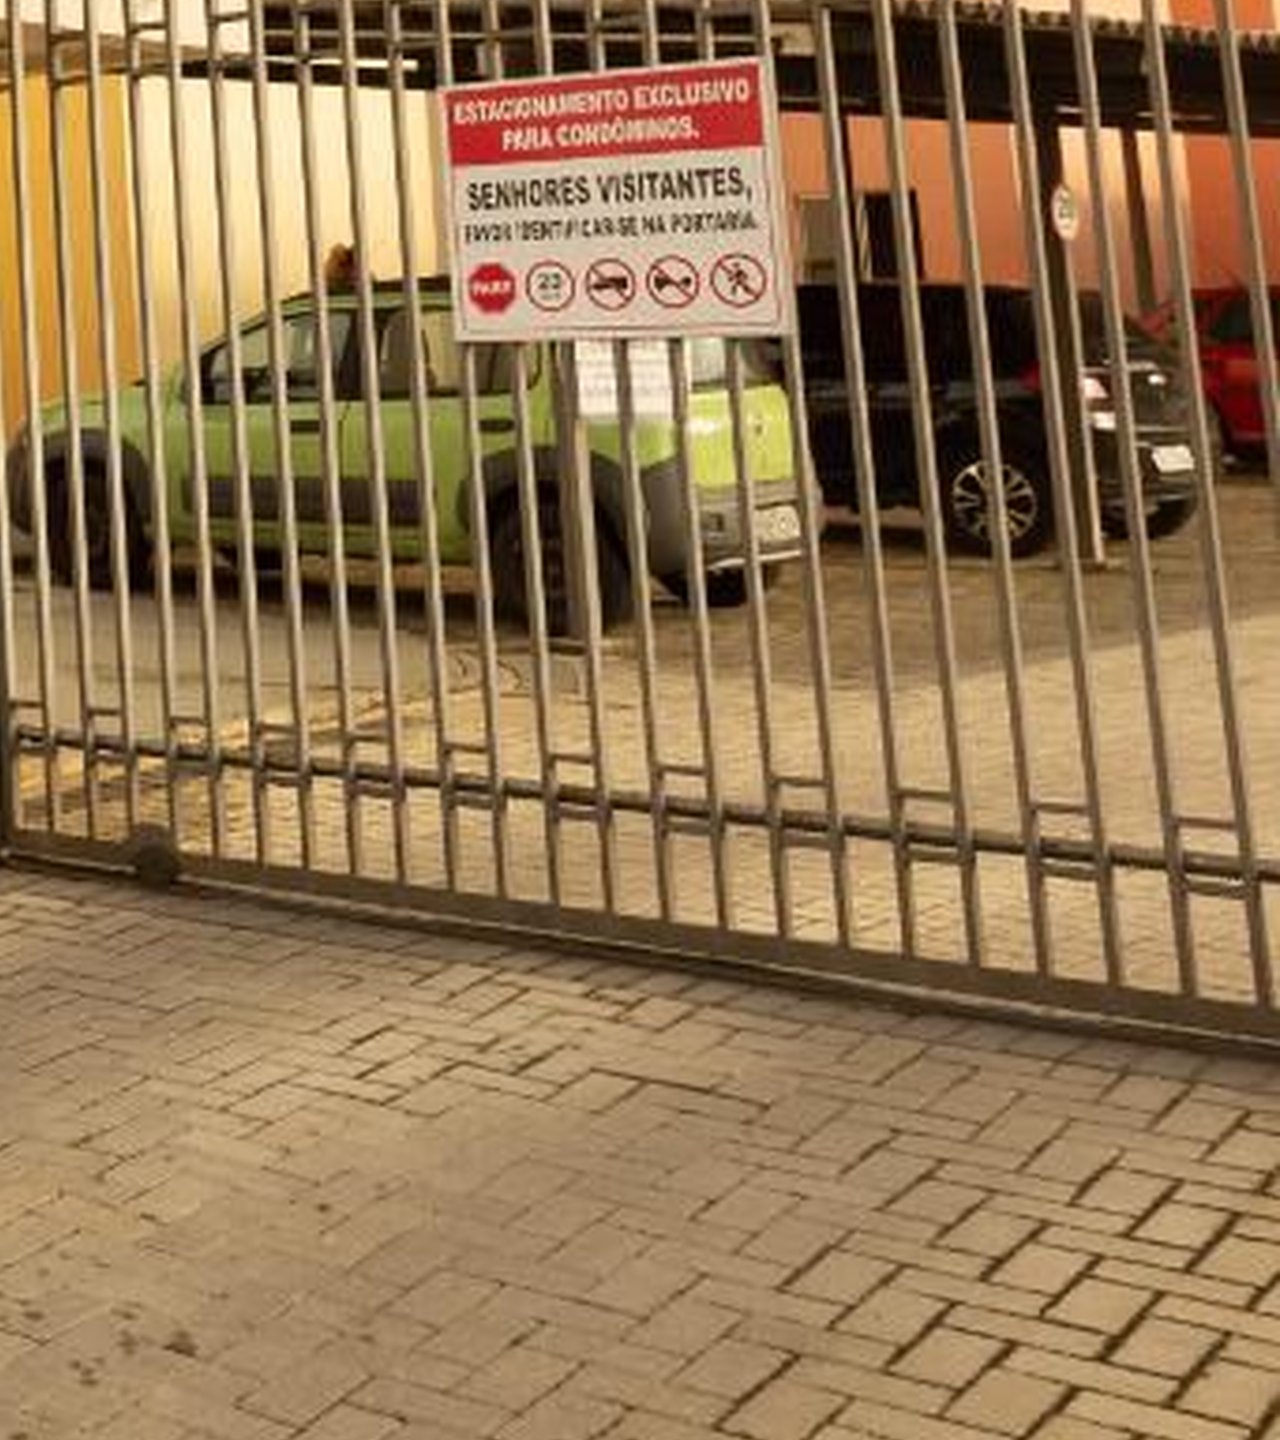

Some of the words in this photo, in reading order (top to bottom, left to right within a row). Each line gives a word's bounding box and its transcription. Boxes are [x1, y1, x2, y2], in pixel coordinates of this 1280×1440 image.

[453, 87, 630, 126] ESTACIONAMENTO
[633, 77, 750, 110] EXCLUSIVO
[501, 124, 554, 152] PARA
[466, 173, 592, 212] SENHORES
[596, 165, 753, 204] VISITANTES,
[643, 213, 669, 236] NA
[472, 278, 513, 297] PARE
